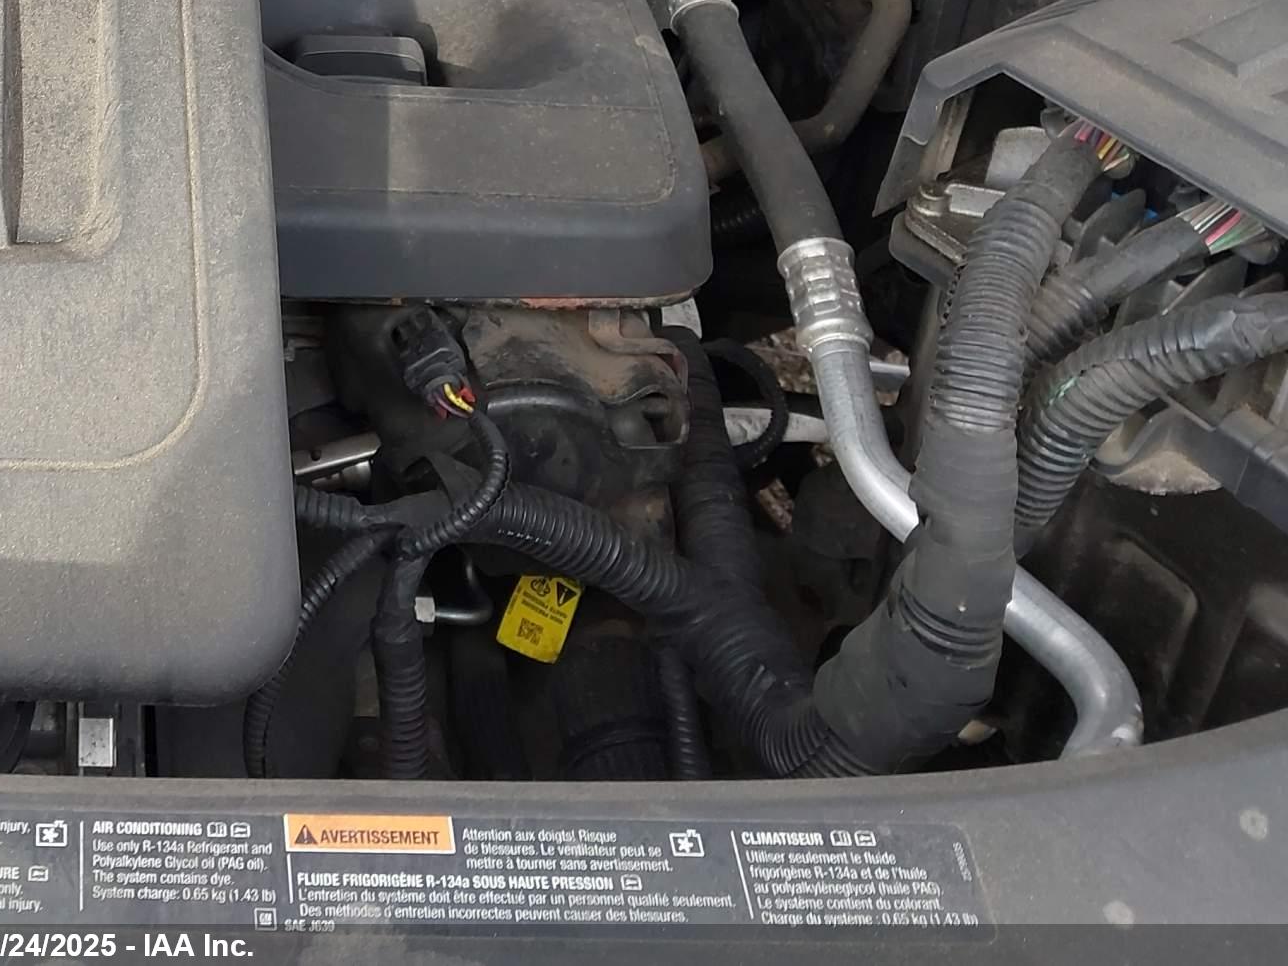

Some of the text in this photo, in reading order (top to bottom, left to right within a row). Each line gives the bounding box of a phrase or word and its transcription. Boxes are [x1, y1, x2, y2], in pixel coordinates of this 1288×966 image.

[93, 821, 202, 836] AIR CONDITIONING
[462, 828, 616, 844] Attention aux doigts! Risque
[320, 830, 440, 844] AVERTISSEMENT
[741, 831, 824, 846] CLIMATISEUR
[92, 840, 272, 856] Use only R-134a Refrigerant and
[464, 844, 662, 858] de blessures. Le ventilateur peut se
[92, 854, 268, 872] Polyalkylene Glycol oil (PAG oil).
[466, 856, 673, 872] mettre à tourner sans avertissement.
[746, 850, 896, 864] Utiliser seulement le fluide
[92, 870, 235, 887] The system contains dye.
[750, 866, 812, 880] frigorigène
[814, 866, 858, 879] R-134a
[862, 867, 872, 879] et
[874, 866, 890, 879] de
[297, 872, 340, 886] FLUIDE
[426, 874, 470, 888] R-134a
[472, 876, 506, 889] SOUS
[508, 876, 550, 890] HAUTE
[552, 876, 613, 890] PRESSION
[92, 886, 276, 904] System charge: 0.65 kg (1.43 lb)
[753, 883, 768, 894] au
[878, 882, 908, 896] (huile
[912, 882, 944, 896] PAG).
[8, 898, 43, 912] injury.
[298, 888, 736, 908] L'entretien du système doit être effectué par un personnel qualifié seulement.
[758, 896, 772, 910] Le
[827, 896, 878, 910] contient
[878, 897, 890, 910] du
[894, 898, 944, 910] colorant.
[300, 903, 688, 922] Des méthodes d'entretien incorrectes peuvent causer des blessures.
[761, 912, 804, 926] Charge
[806, 913, 821, 924] du
[912, 914, 928, 927] kg
[284, 918, 306, 932] SAE
